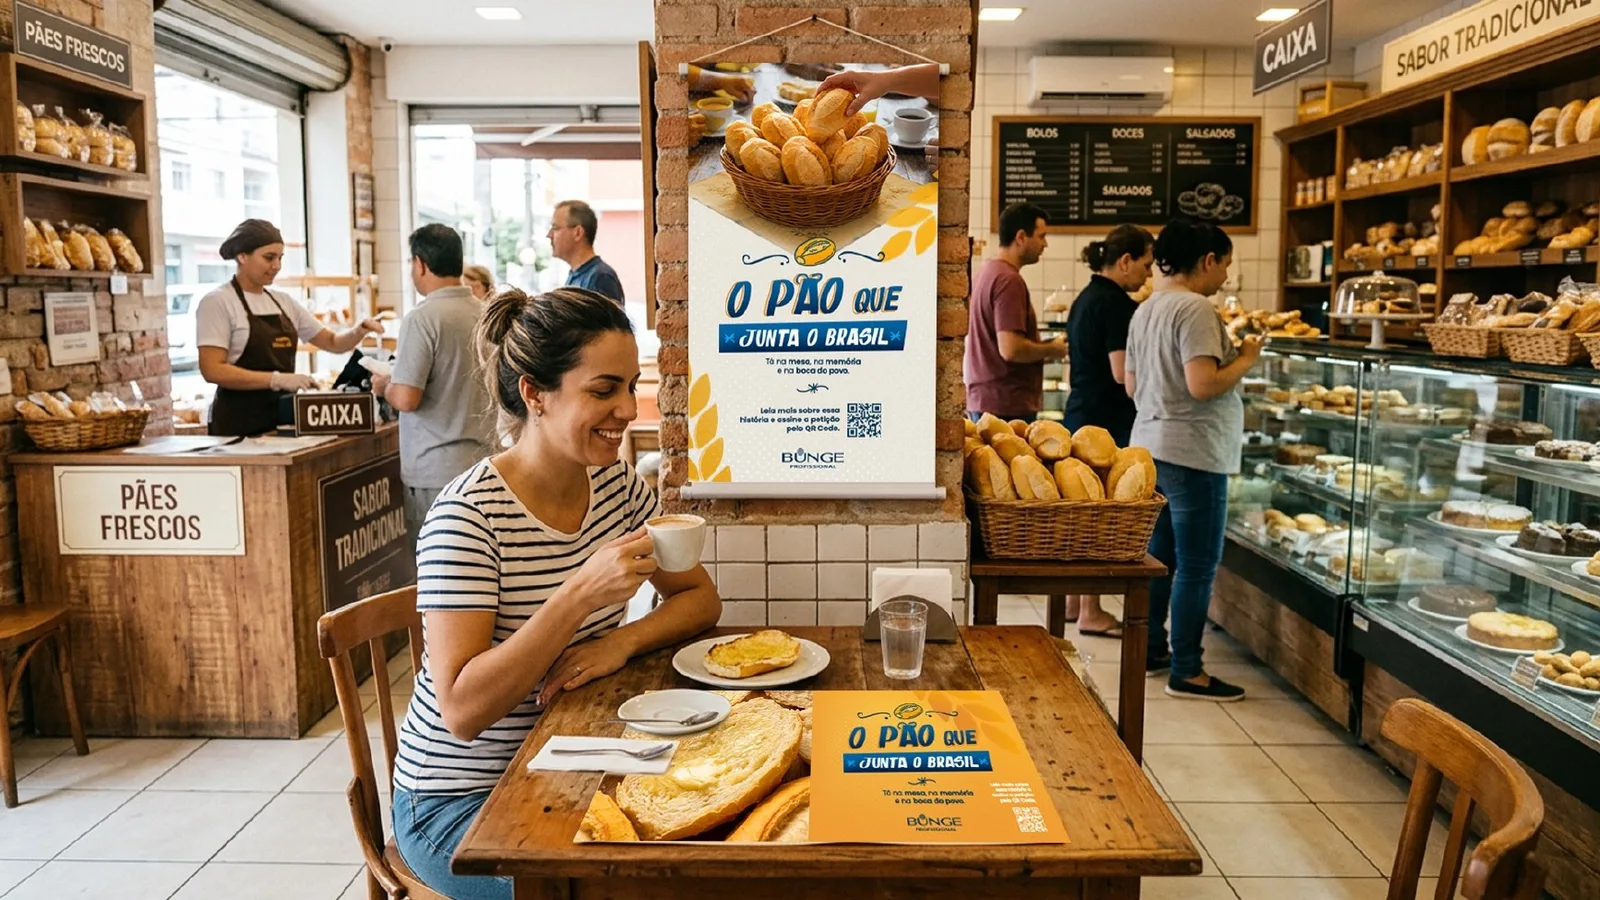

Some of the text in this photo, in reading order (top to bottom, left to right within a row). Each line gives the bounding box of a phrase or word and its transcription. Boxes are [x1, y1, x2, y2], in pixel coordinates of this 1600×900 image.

[26, 20, 126, 73] PÃES FRESCOS
[1263, 21, 1318, 73] CAIXA
[1397, 0, 1592, 78] SABOR TRADICIONA
[1027, 128, 1059, 138] BOLOS
[1112, 128, 1144, 138] DOCES
[1102, 185, 1153, 196] SALGADOS
[725, 273, 903, 318] O PÃO QUE
[739, 327, 889, 348] JUNTA O BRASIL
[796, 367, 816, 375] boca
[307, 404, 363, 426] CAIXA
[782, 451, 844, 463] BUNGE
[121, 479, 178, 510] PÃES
[353, 477, 391, 521] SABOR
[101, 515, 202, 540] FRESCOS
[335, 506, 408, 571] TRADICIONAL
[848, 721, 977, 750] O PÃO QUE
[859, 755, 980, 768] JUNTA O BRASIL
[907, 816, 963, 827] BUNGE
